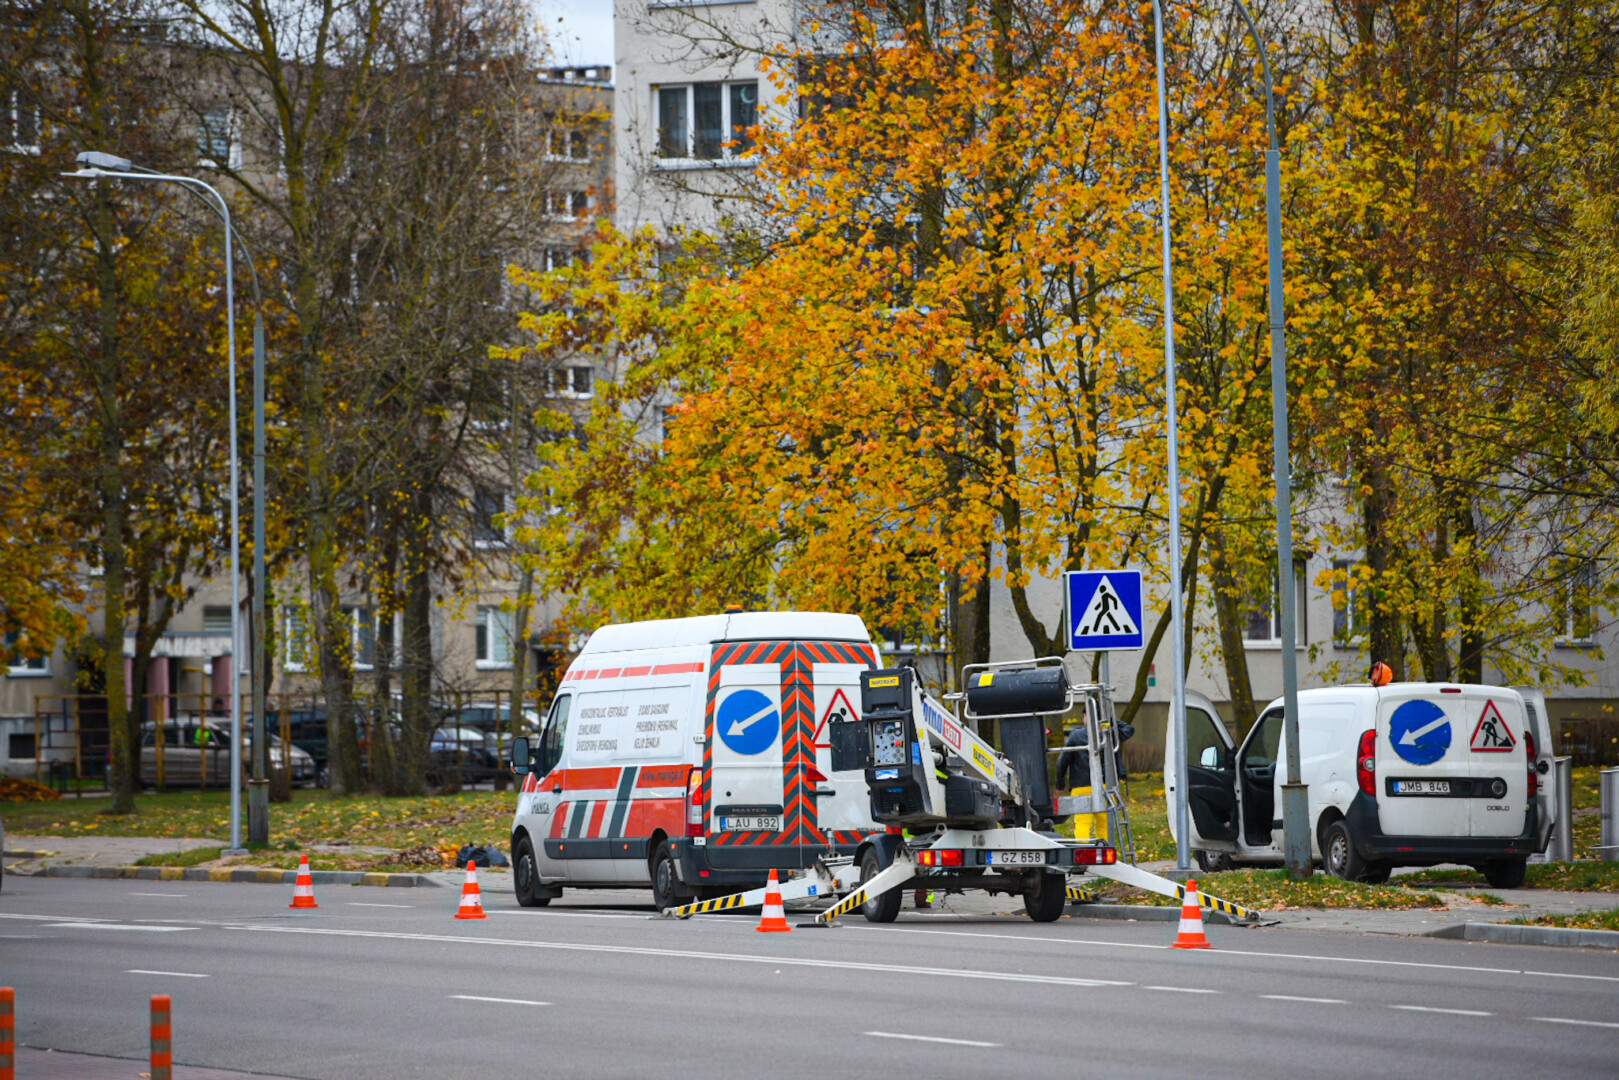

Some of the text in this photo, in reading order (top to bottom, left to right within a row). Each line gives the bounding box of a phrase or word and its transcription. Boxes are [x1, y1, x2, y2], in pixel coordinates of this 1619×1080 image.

[923, 701, 943, 734] DINO
[1400, 781, 1449, 792] JMB 846
[726, 817, 777, 828] LAU 892
[1001, 852, 1041, 863] GZ 658
